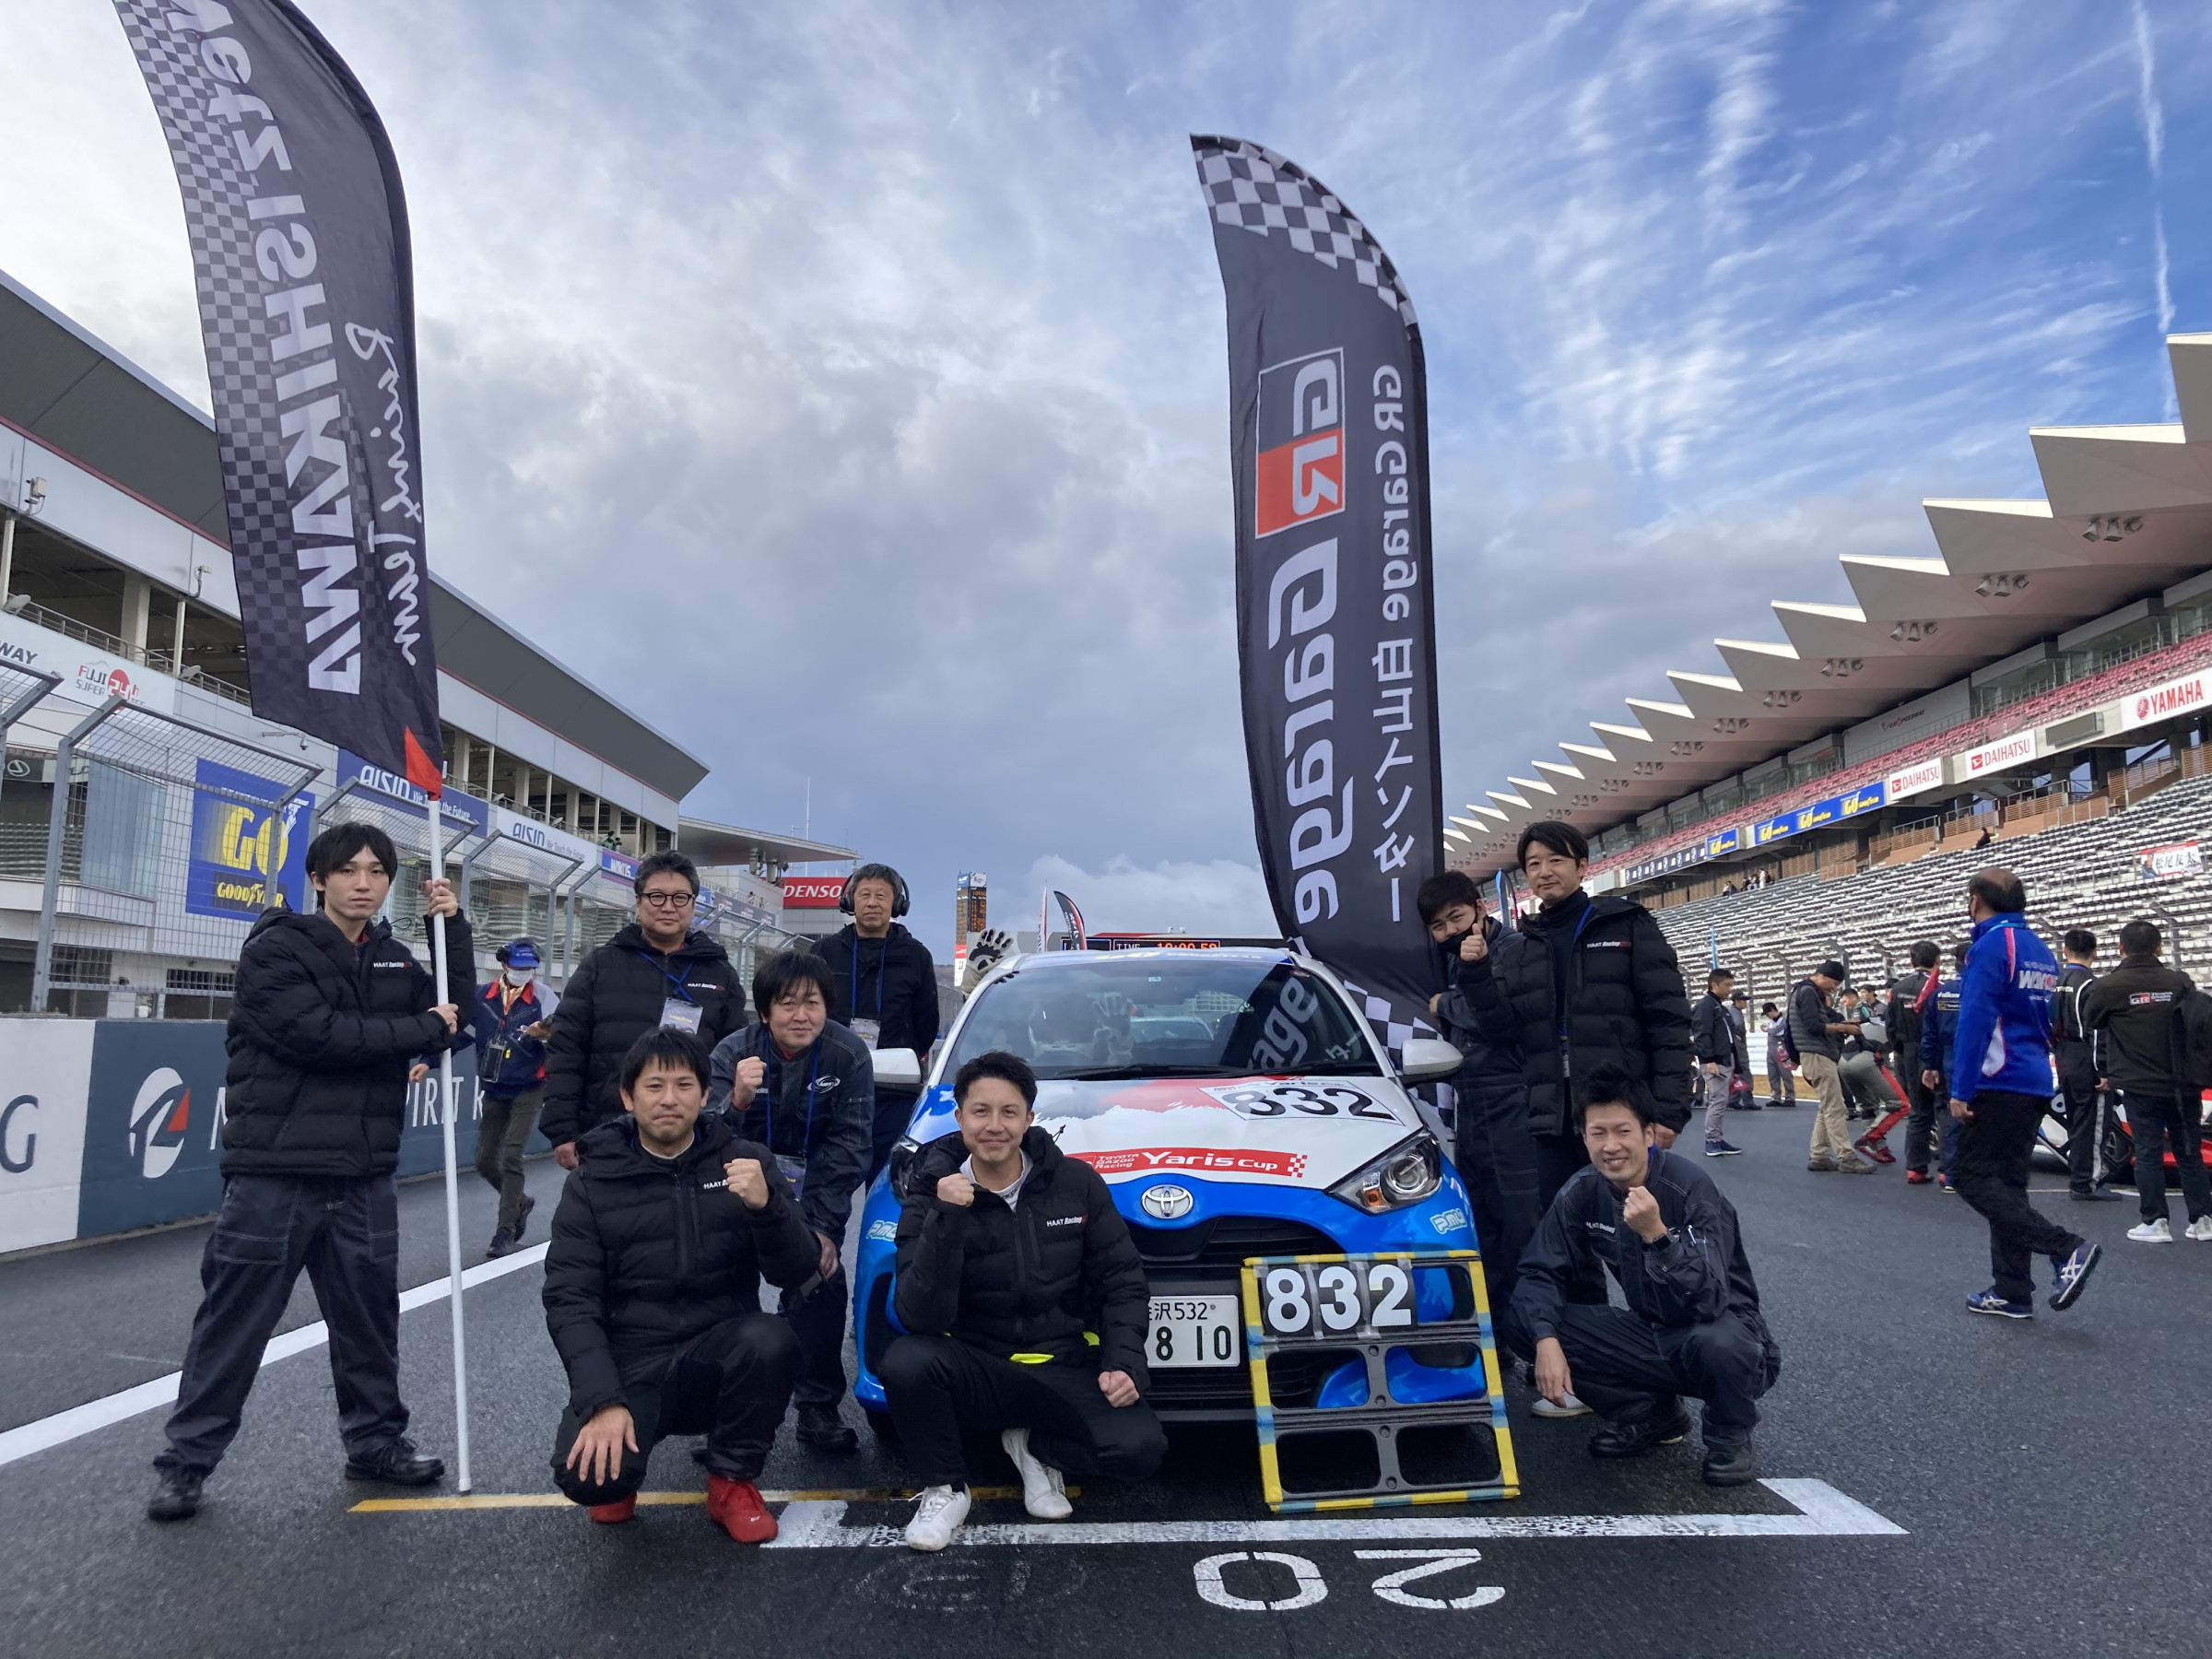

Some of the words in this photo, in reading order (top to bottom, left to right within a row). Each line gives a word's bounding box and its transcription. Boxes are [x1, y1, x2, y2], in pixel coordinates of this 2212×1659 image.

[78, 665, 108, 686] FUJI
[76, 678, 106, 696] SUPER
[2150, 679, 2204, 714] YAMAHA
[1984, 738, 2030, 766] DAIHATSU
[1902, 765, 1940, 790] DAIHATSU
[783, 885, 842, 899] DENSO
[1221, 1087, 1396, 1117] 832
[1094, 1161, 1133, 1170] Racing
[1141, 1152, 1234, 1168] Yaris
[1237, 1158, 1278, 1171] Cup
[704, 1181, 722, 1190] HAAT
[1047, 1218, 1064, 1227] HAAT
[1265, 1264, 1412, 1333] 832
